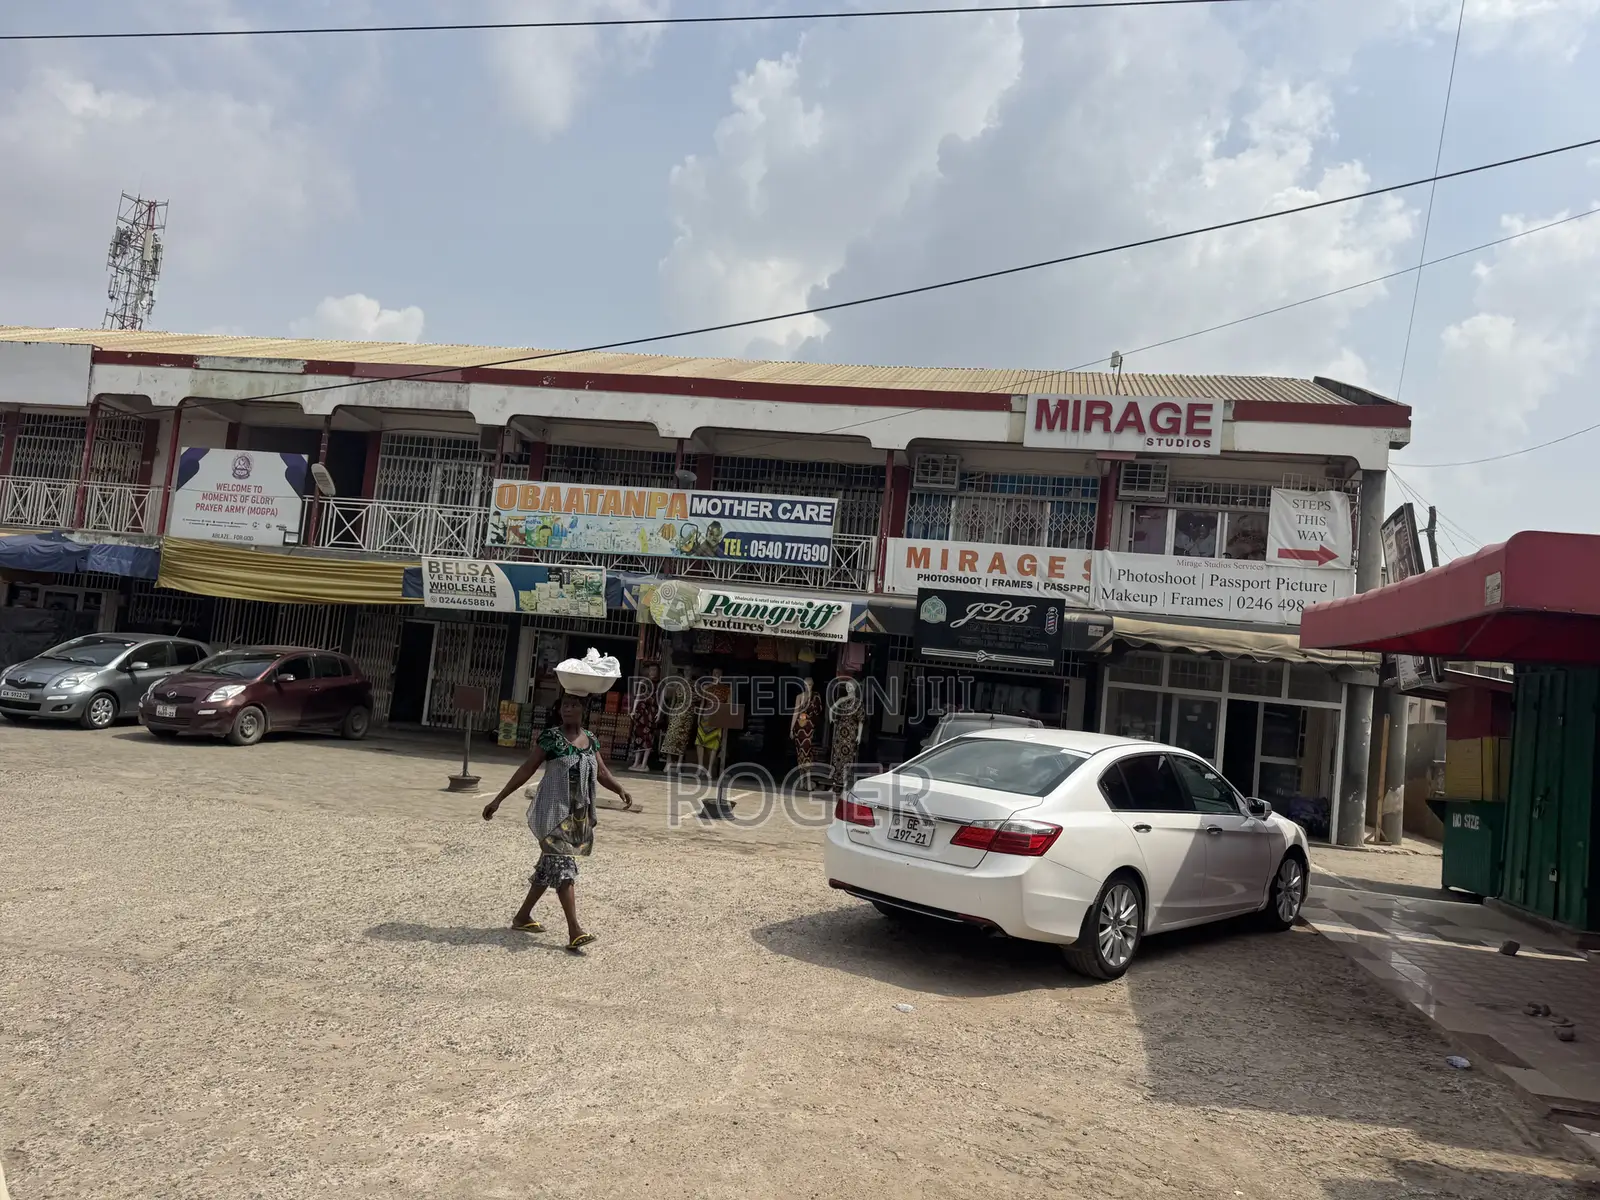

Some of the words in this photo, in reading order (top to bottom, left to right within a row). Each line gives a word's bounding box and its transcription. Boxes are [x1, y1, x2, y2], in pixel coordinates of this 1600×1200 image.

[1034, 398, 1214, 436] MIRAGE
[1146, 437, 1211, 448] STUDIOS
[216, 482, 251, 493] WELCOME
[254, 485, 262, 494] TO
[202, 492, 238, 503] MOMENTS
[240, 495, 249, 504] OF
[250, 496, 274, 506] GLORY
[496, 483, 689, 521] OBAATANPA
[1292, 498, 1332, 511] STEPS
[195, 502, 222, 512] PRAYER
[224, 505, 246, 514] ARMY
[247, 506, 278, 517] (MOGPA)
[692, 497, 773, 519] MOTHER
[777, 502, 832, 522] CARE
[1295, 514, 1326, 526] THIS
[1296, 529, 1329, 542] WAY
[750, 540, 782, 560] 0540
[784, 542, 828, 562] 777590
[428, 560, 495, 577] BELSA
[906, 546, 1067, 578] MIRAGE
[1176, 558, 1202, 569] Mirage
[1204, 560, 1232, 570] Studios
[1233, 562, 1264, 571] Services
[429, 574, 496, 584] VENTURES
[916, 573, 983, 585] PHOTOSHOOT
[992, 578, 1033, 589] FRAMES
[1117, 568, 1197, 586] Photoshoot
[1210, 574, 1270, 592] Passport
[1276, 577, 1328, 593] Picture
[429, 582, 496, 594] WHOLESALE
[438, 596, 495, 607] 0244658816
[1101, 587, 1158, 604] Makeup
[1171, 592, 1224, 608] Frames
[1236, 596, 1273, 611] 0246
[1278, 598, 1304, 612] 498
[701, 594, 842, 629] Pamgriff
[702, 618, 764, 632] ventures
[907, 818, 920, 831] GE
[1452, 812, 1461, 828] NO
[1464, 814, 1480, 830] SIZE
[894, 828, 927, 844] 197-21
